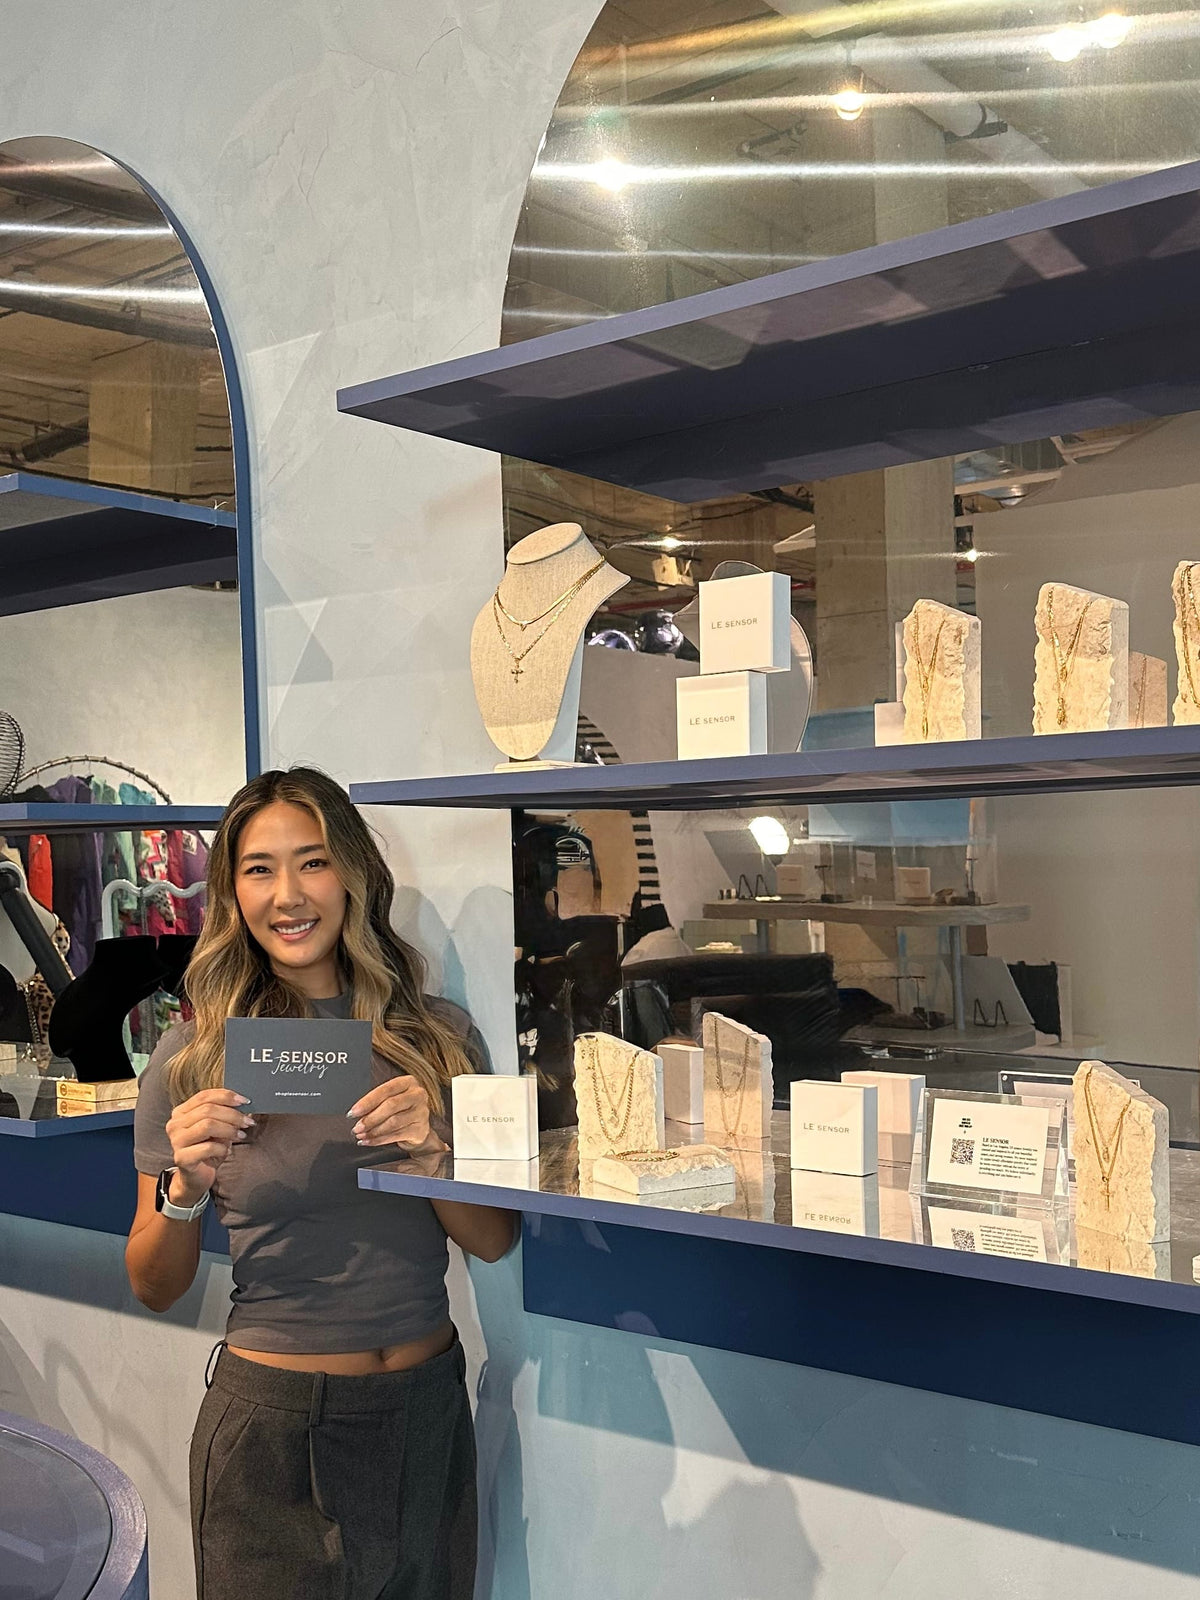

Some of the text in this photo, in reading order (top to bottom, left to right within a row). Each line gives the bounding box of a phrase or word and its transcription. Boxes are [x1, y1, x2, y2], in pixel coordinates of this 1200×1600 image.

[711, 618, 758, 630] LE SENSOR
[689, 715, 736, 726] LE SENSOR
[250, 1048, 348, 1064] LE SENSOR
[271, 1056, 329, 1079] Jewelry
[466, 1115, 479, 1123] LE
[803, 1122, 850, 1134] LE SENSOR
